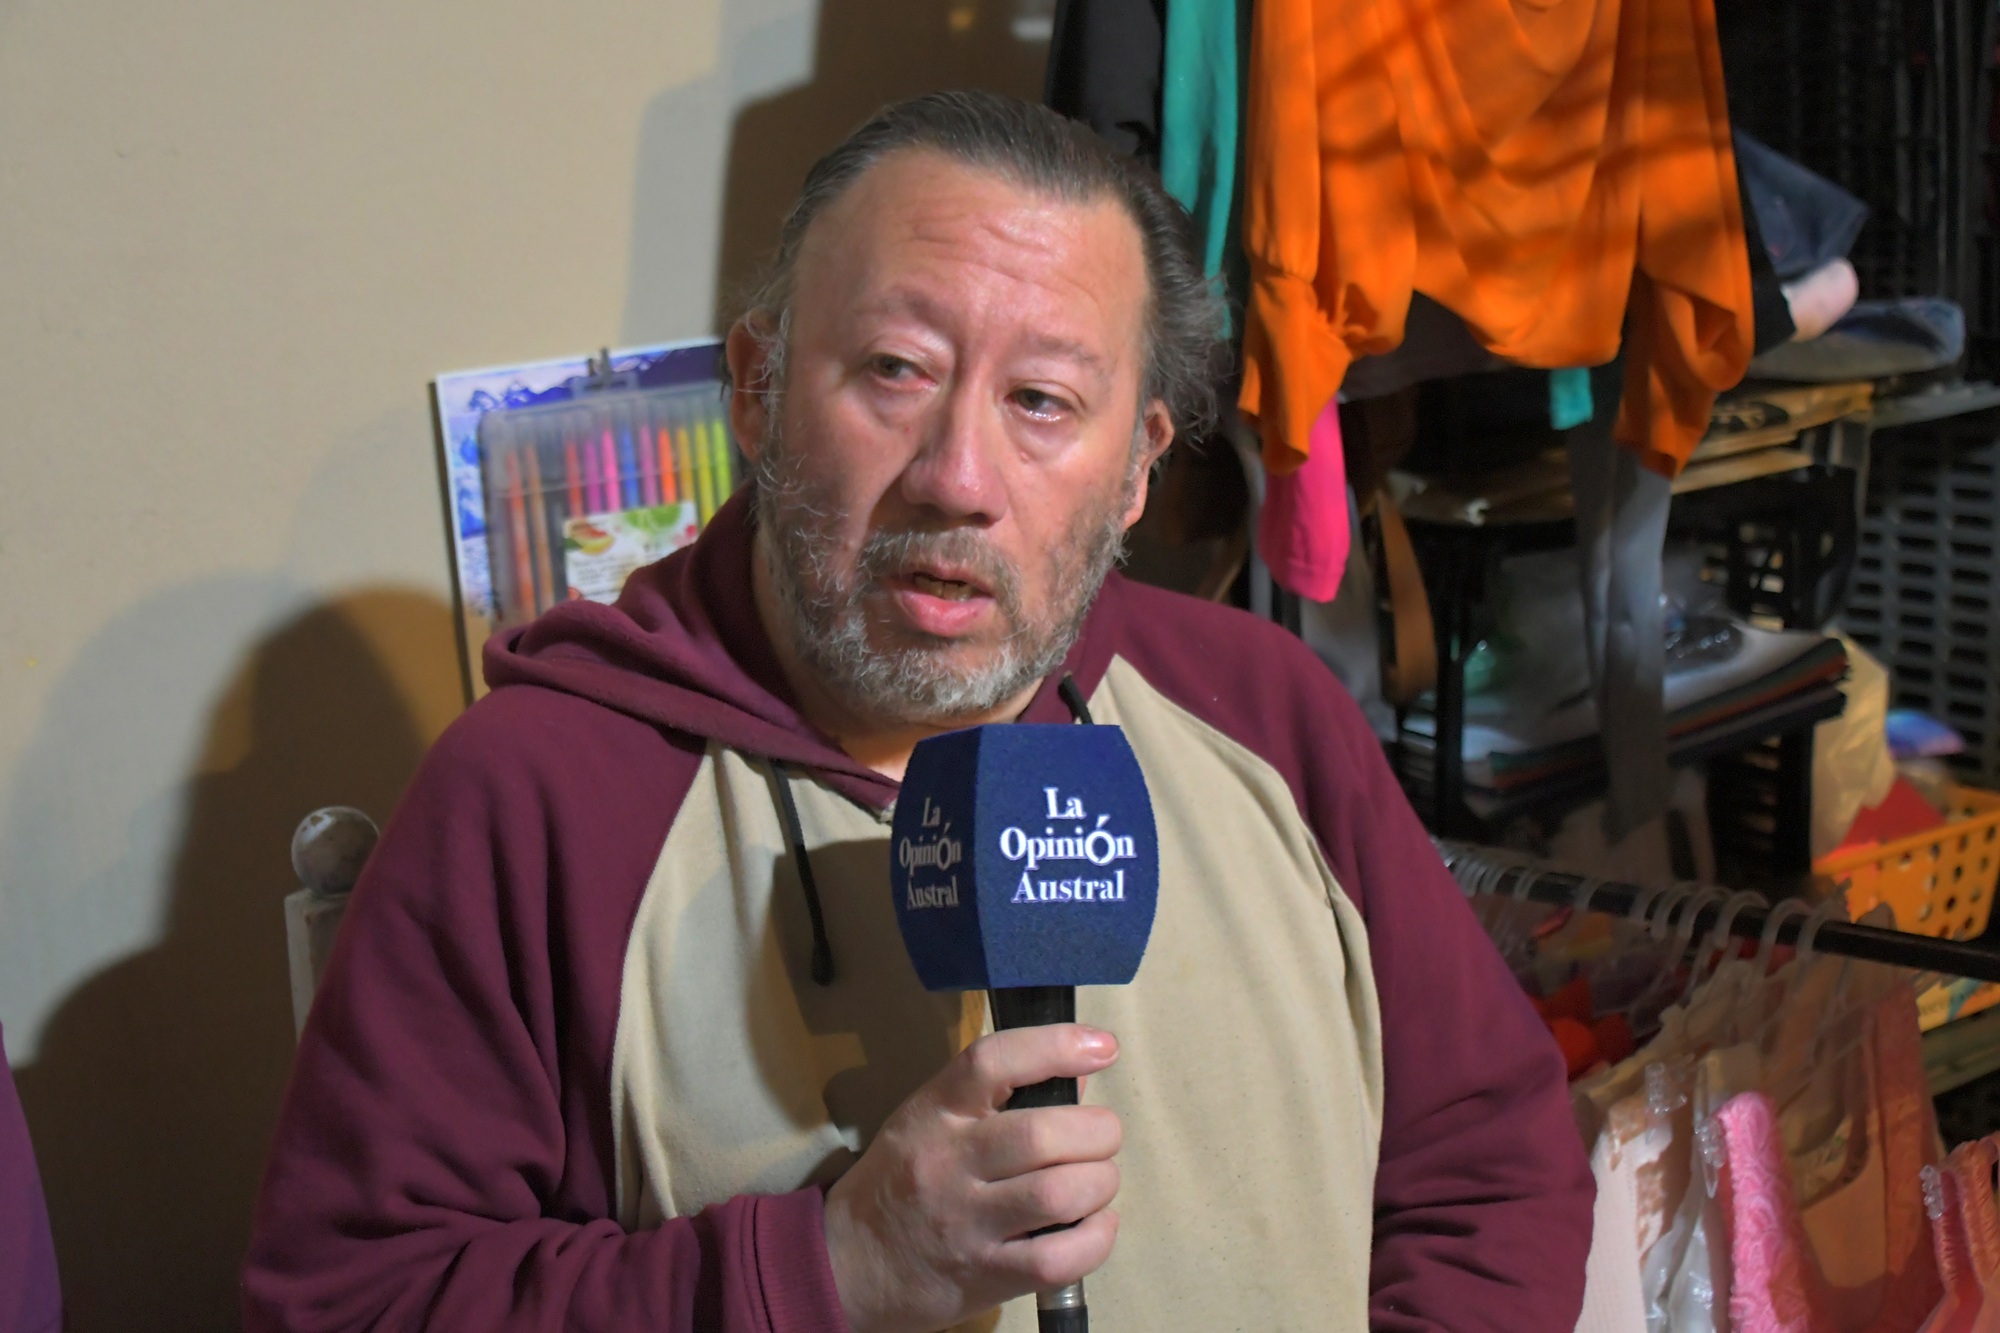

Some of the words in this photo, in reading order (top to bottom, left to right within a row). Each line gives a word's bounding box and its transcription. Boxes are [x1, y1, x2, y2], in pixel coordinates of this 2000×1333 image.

[921, 798, 941, 826] La
[1043, 787, 1086, 819] La
[908, 876, 959, 909] Austral
[1011, 870, 1125, 903] Austral
